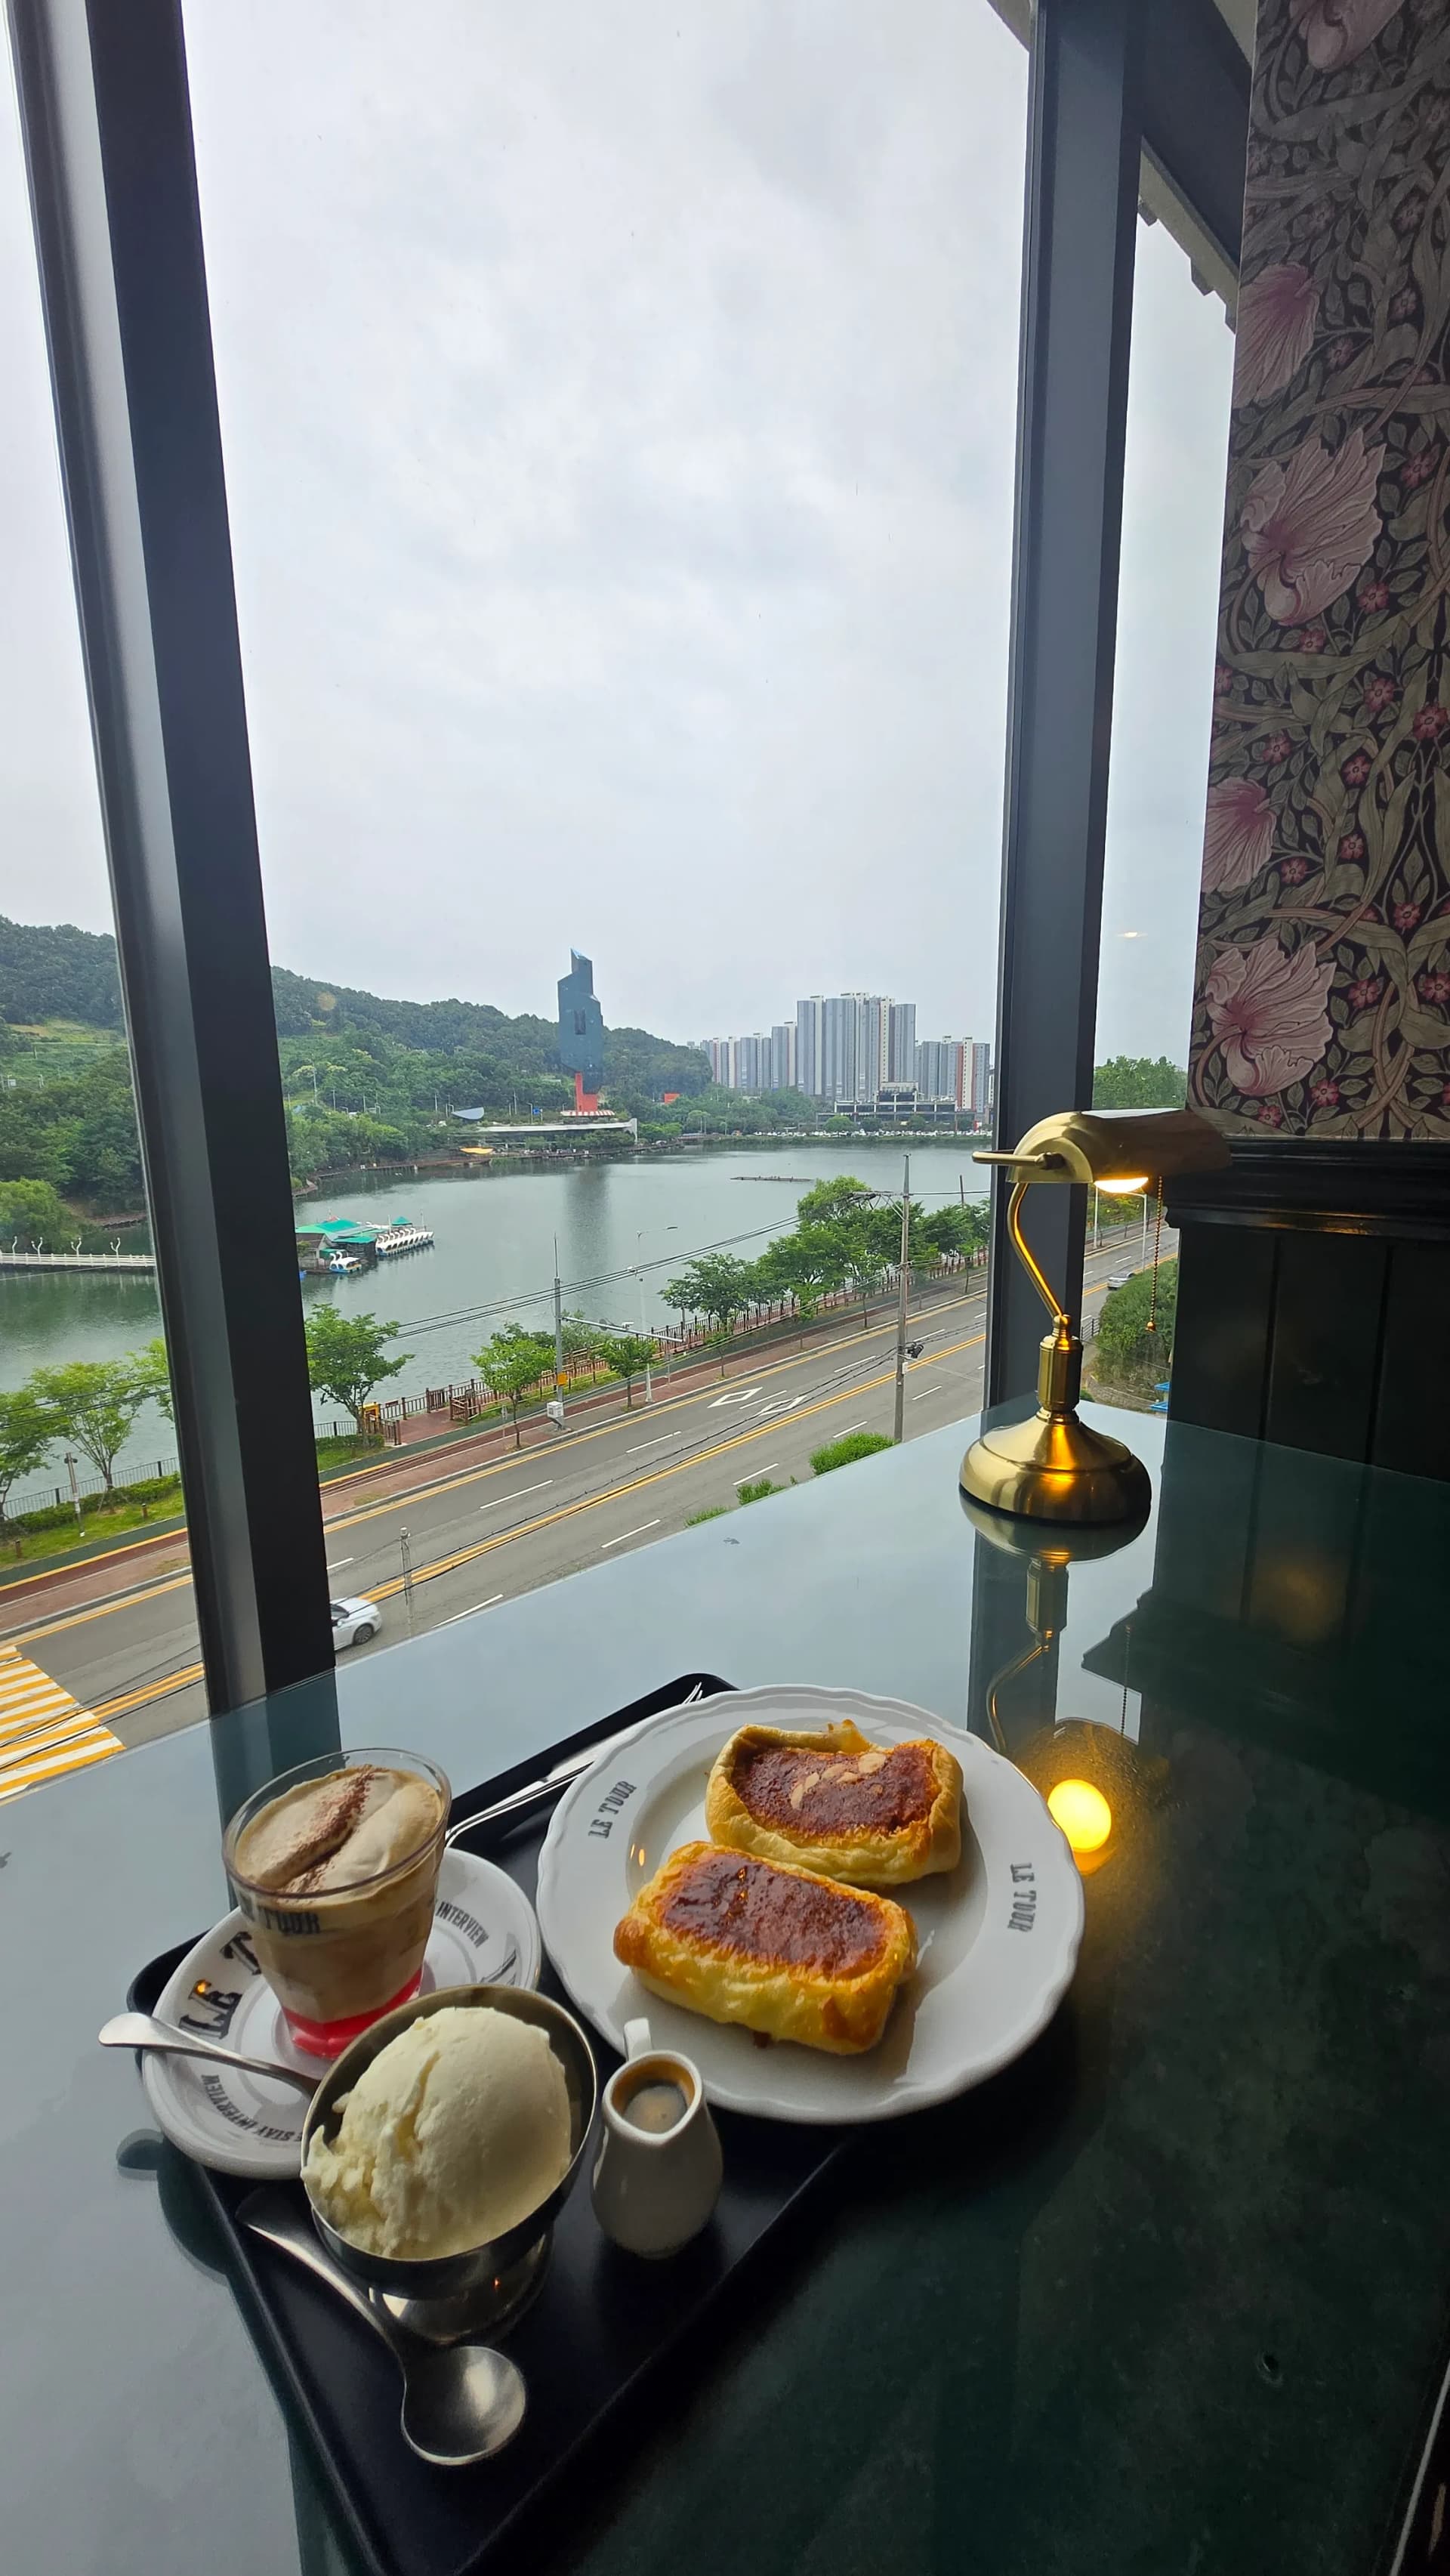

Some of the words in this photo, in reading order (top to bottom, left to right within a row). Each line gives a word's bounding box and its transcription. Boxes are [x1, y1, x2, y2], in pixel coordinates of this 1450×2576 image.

[598, 1781, 637, 1815] TOUR
[588, 1818, 613, 1839] LE
[1010, 1862, 1035, 1883] LE
[435, 1901, 489, 1949] INTERVIEW
[1007, 1890, 1037, 1932] TOUR
[178, 1978, 243, 2040] LE
[200, 2074, 258, 2130] INTERVIEW
[251, 2125, 295, 2142] STAY
